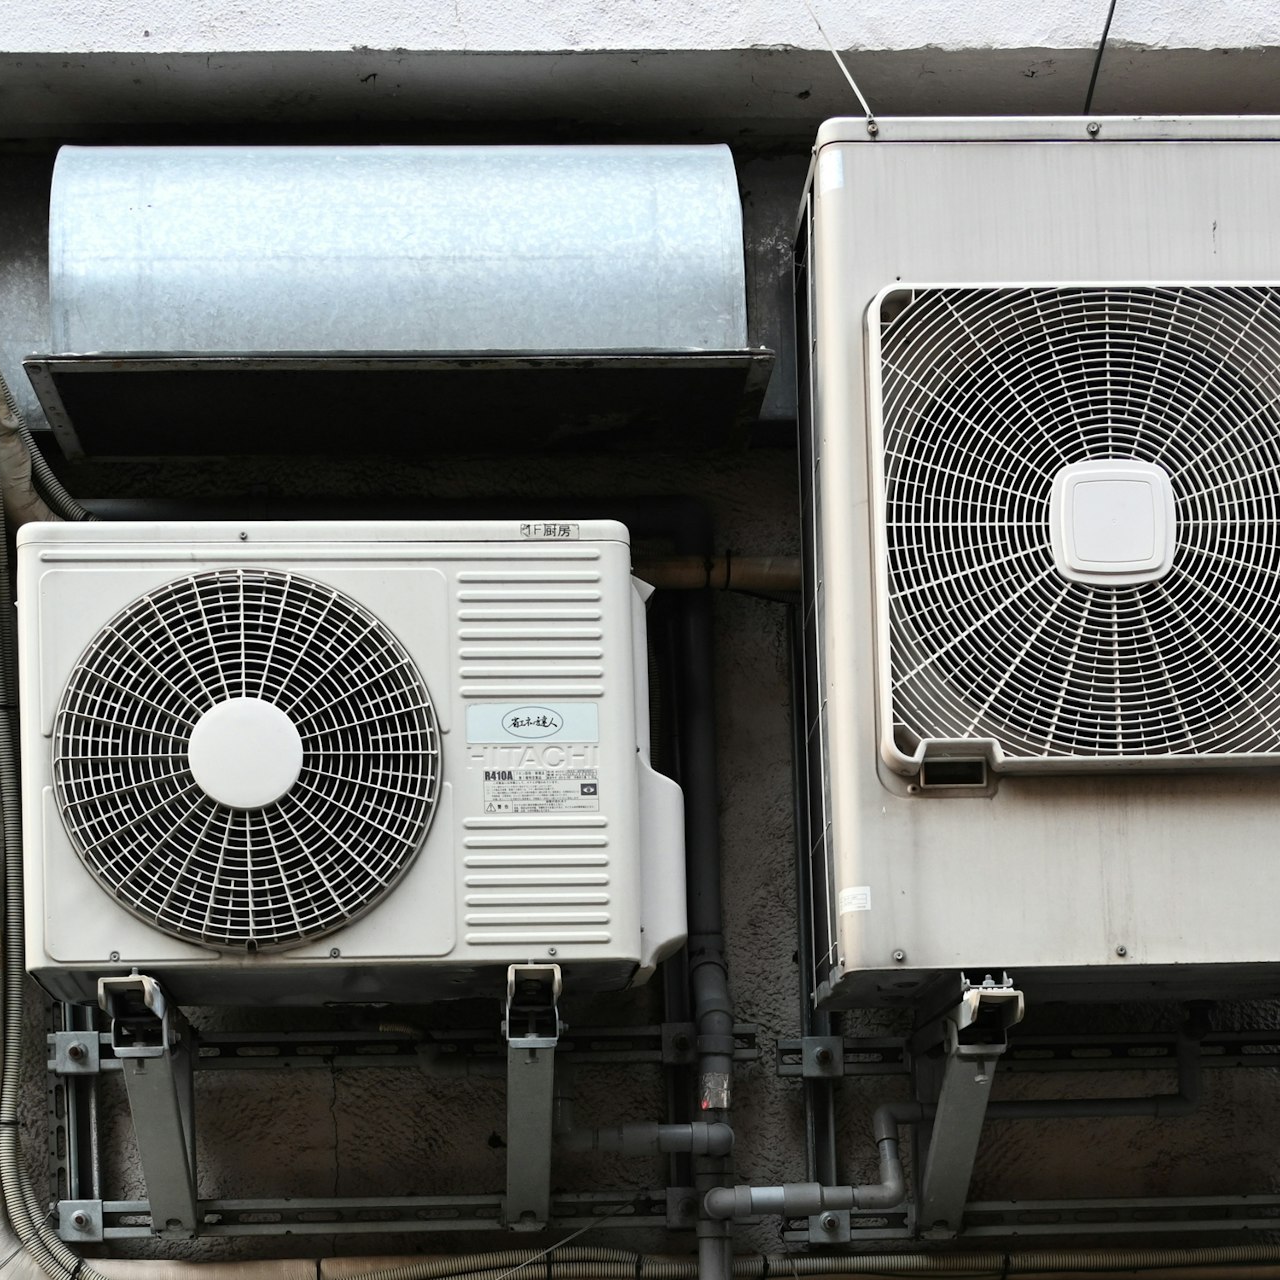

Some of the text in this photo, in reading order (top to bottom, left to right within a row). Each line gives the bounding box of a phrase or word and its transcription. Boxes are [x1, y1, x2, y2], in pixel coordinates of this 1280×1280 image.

[507, 715, 558, 729] 省エネの達人
[466, 745, 599, 769] HITACHI
[484, 770, 513, 781] R410A
